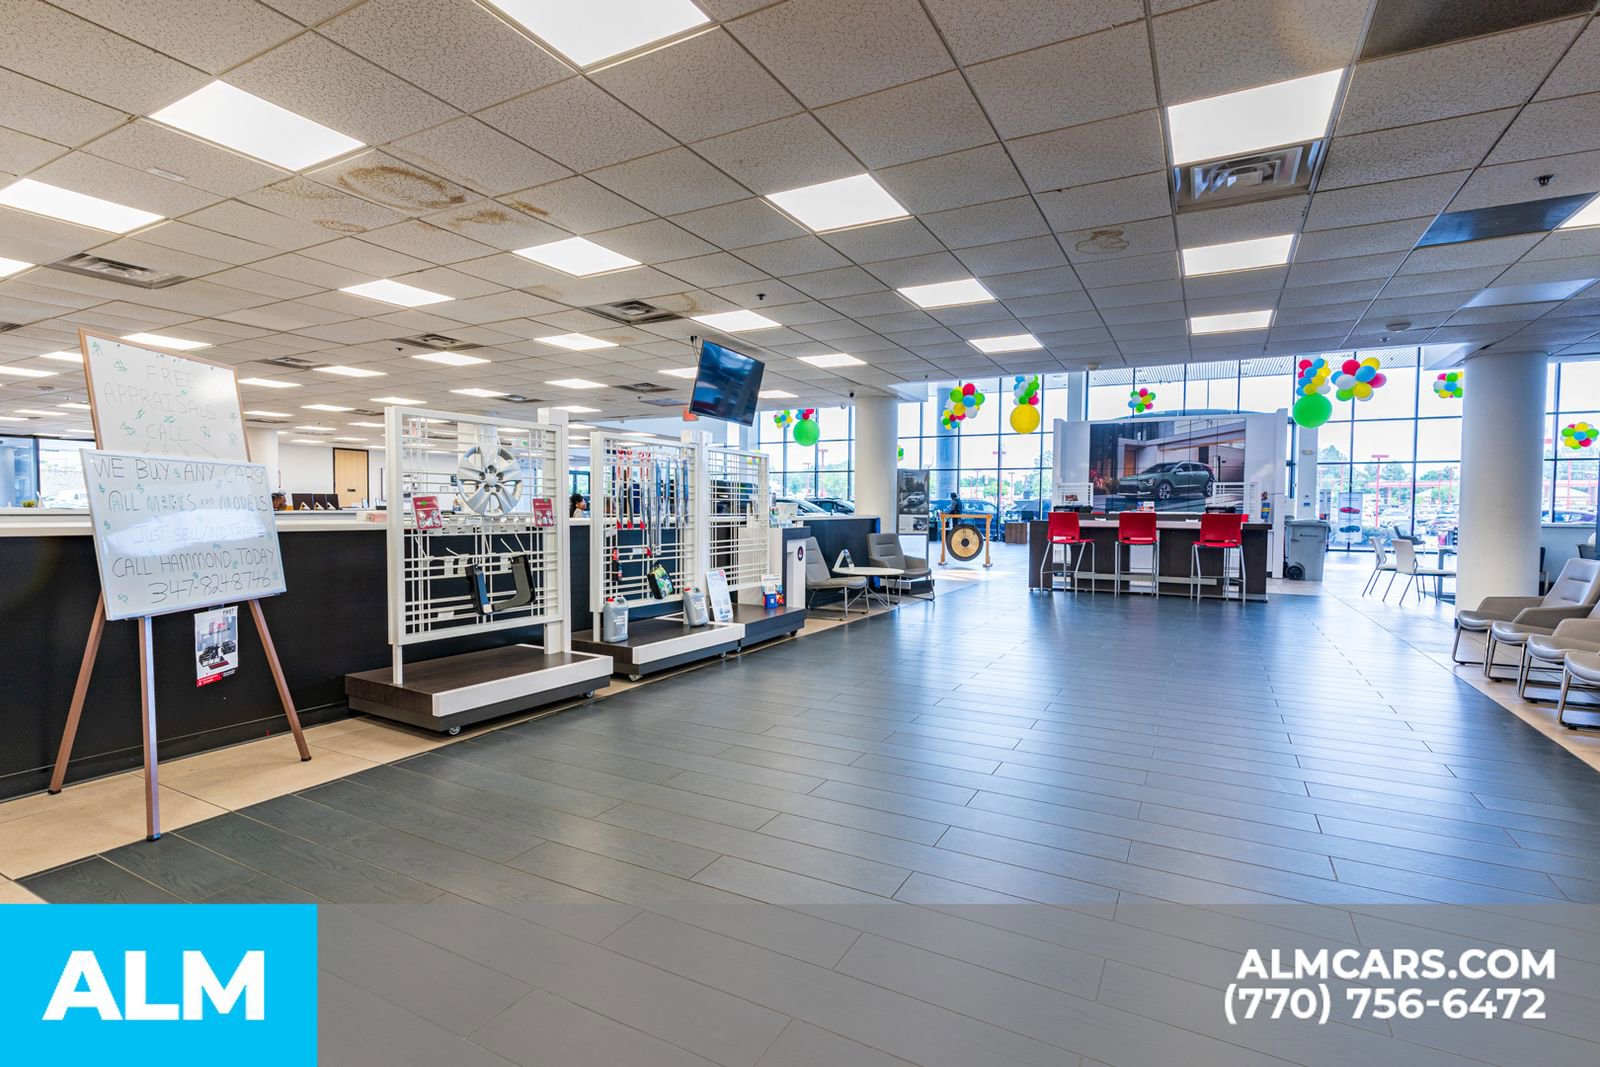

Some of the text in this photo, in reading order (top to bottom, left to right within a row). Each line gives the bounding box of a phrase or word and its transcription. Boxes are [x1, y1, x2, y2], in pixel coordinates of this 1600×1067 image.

[146, 364, 198, 390] FREE
[103, 382, 217, 420] APPRAISALS
[146, 424, 192, 441] CALL
[92, 457, 264, 485] WE BUY ANY CARS
[108, 490, 140, 512] ALL
[146, 493, 197, 513] MAKES
[219, 495, 269, 512] MODELS
[133, 524, 168, 544] JUST
[112, 547, 276, 578] CALL HAMMOND TODAY
